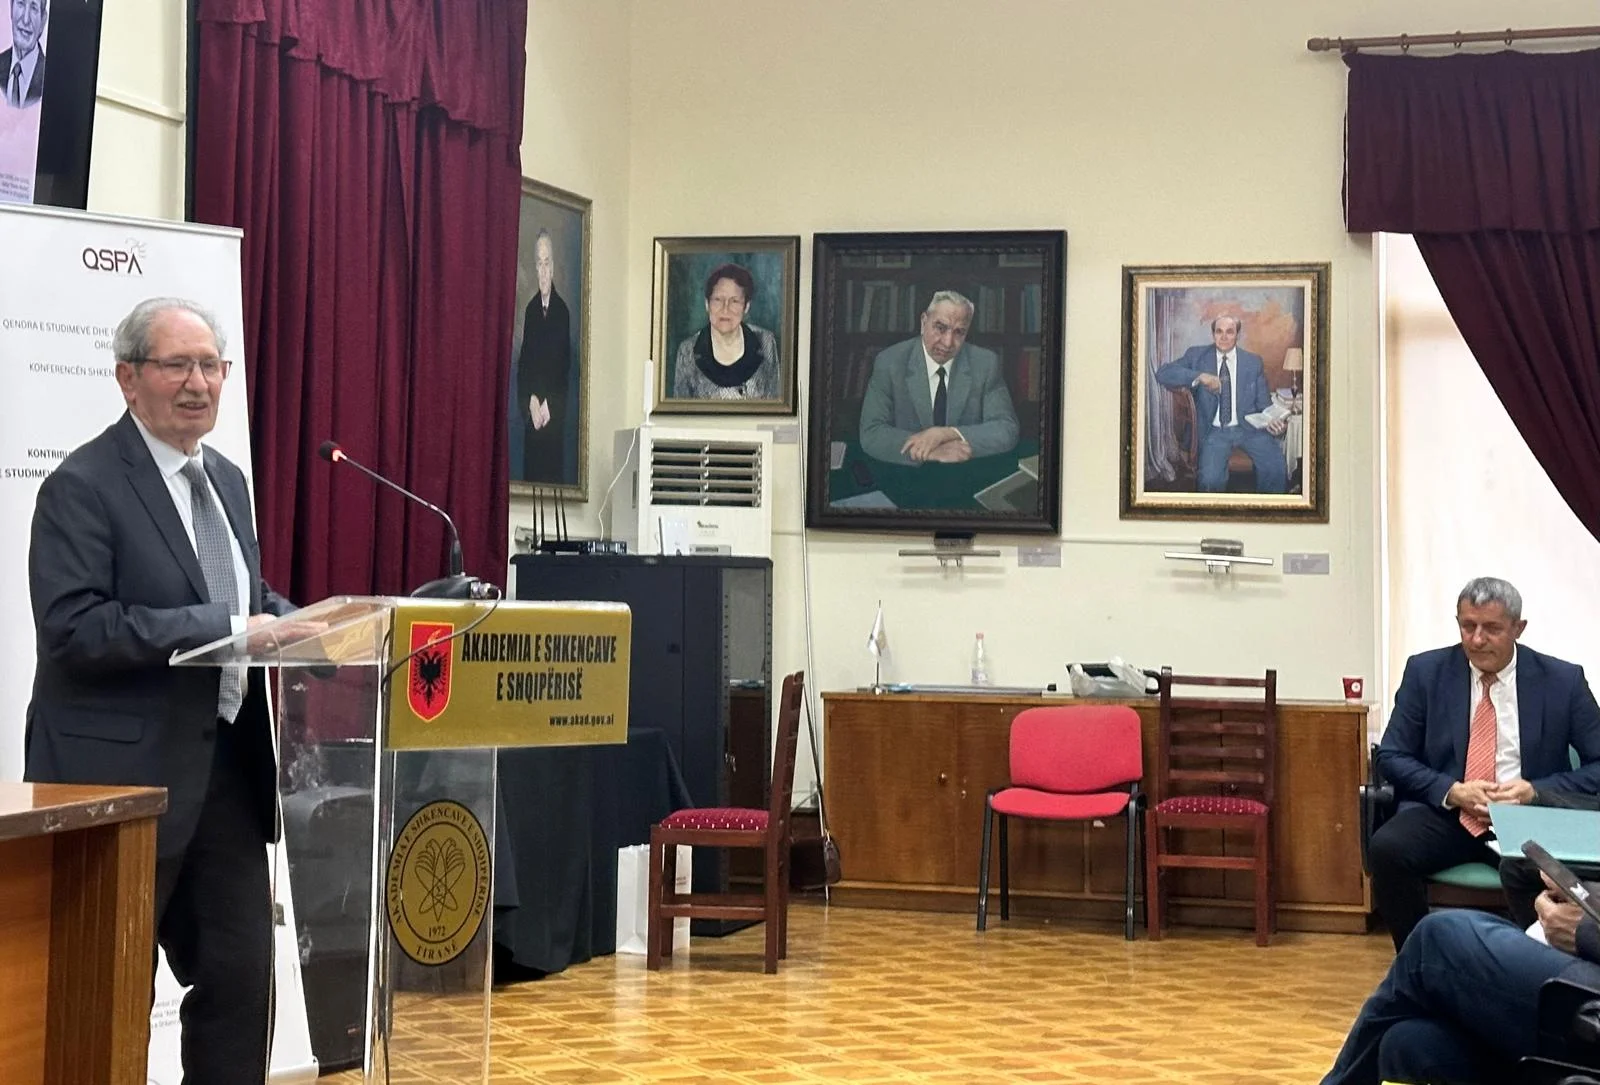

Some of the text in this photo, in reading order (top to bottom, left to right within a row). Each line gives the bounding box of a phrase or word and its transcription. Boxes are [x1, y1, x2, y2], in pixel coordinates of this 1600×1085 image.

[82, 246, 143, 275] QSPA
[2, 318, 38, 330] QENDRA
[45, 322, 91, 336] STUDIMEVE
[92, 326, 109, 337] DHE
[461, 632, 617, 664] AKADEMIA E SHKENCAVE
[496, 667, 583, 704] E SHQIPËRISË
[549, 713, 614, 727] www.akad.gov.al
